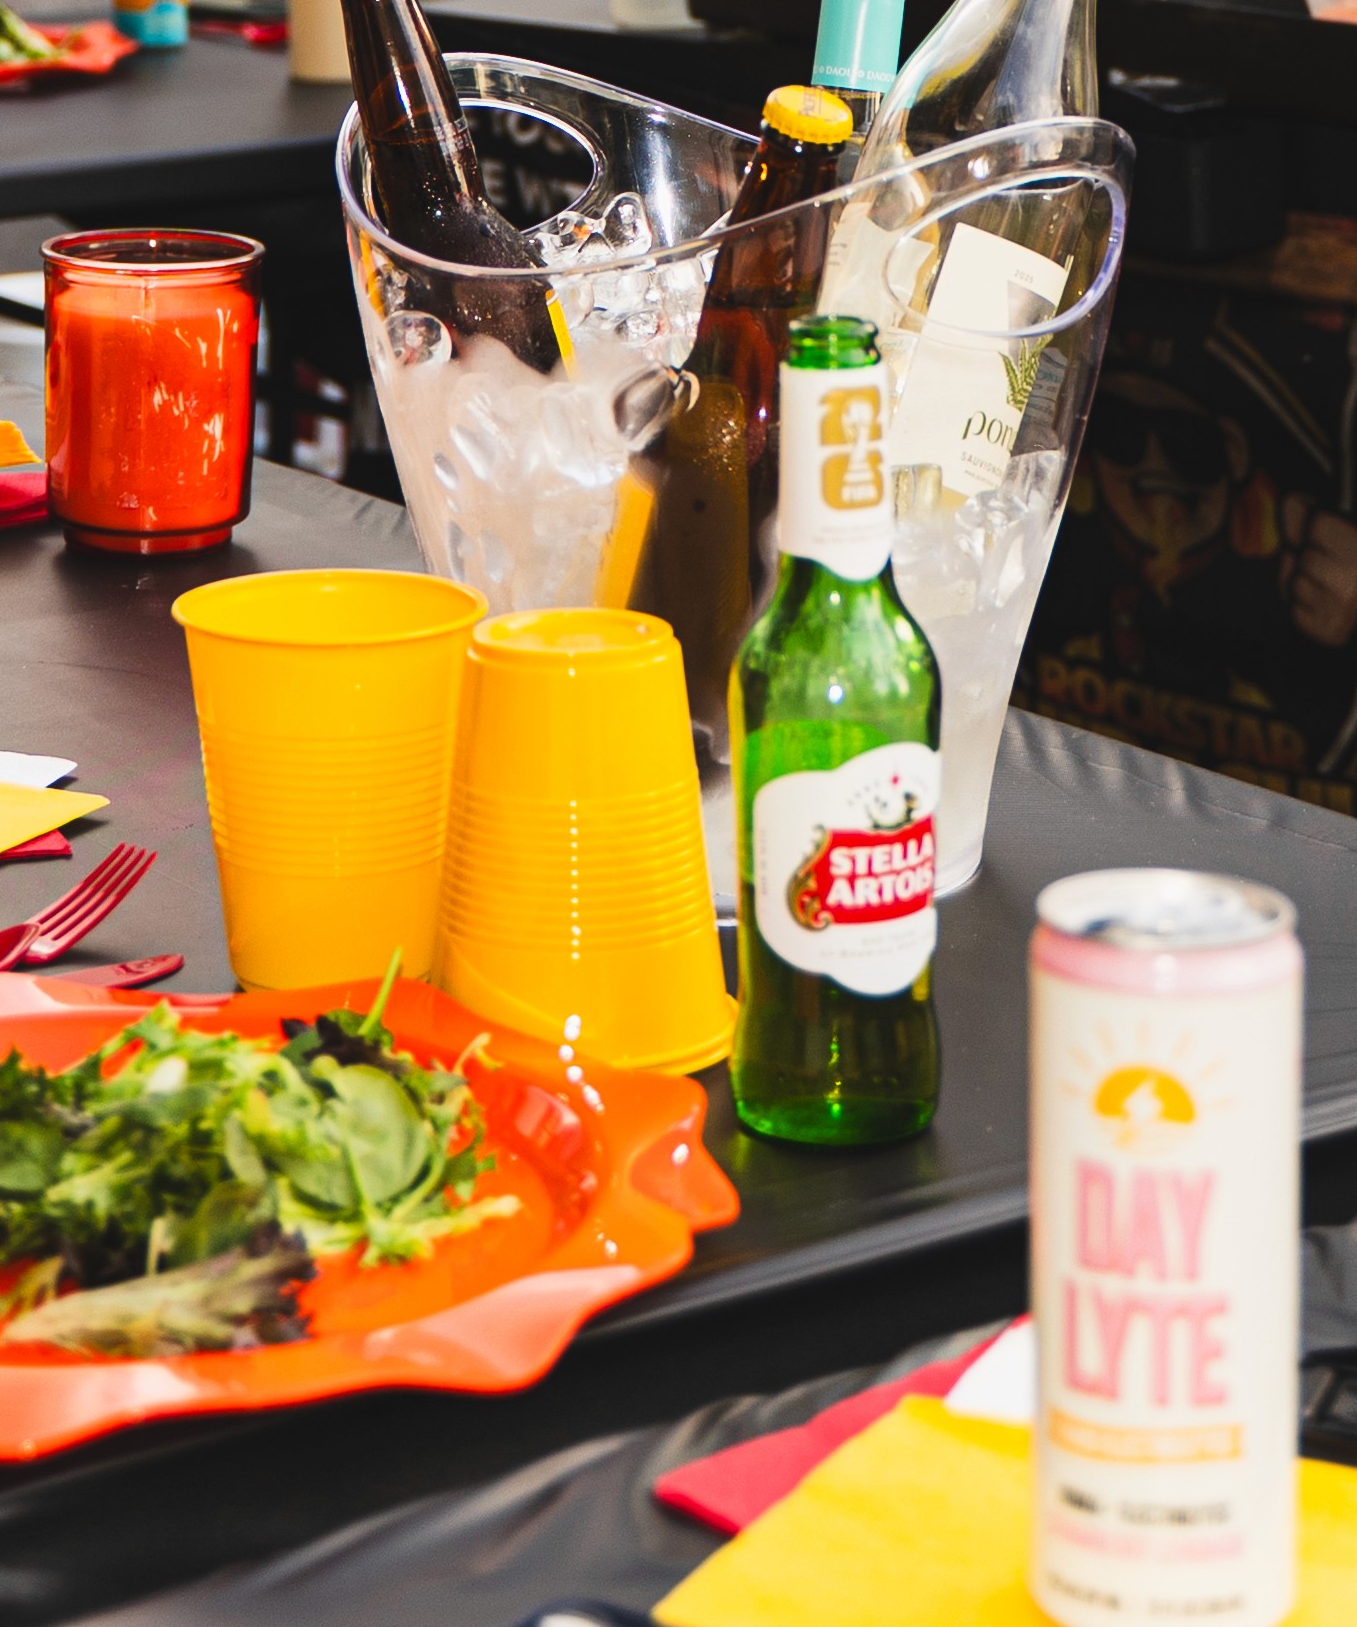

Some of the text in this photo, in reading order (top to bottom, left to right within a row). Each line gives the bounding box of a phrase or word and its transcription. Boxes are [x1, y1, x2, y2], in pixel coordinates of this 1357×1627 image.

[962, 410, 1014, 452] pon
[828, 831, 934, 877] STELLA
[1074, 1155, 1218, 1282] DAY
[1061, 1276, 1230, 1410] LYTE
